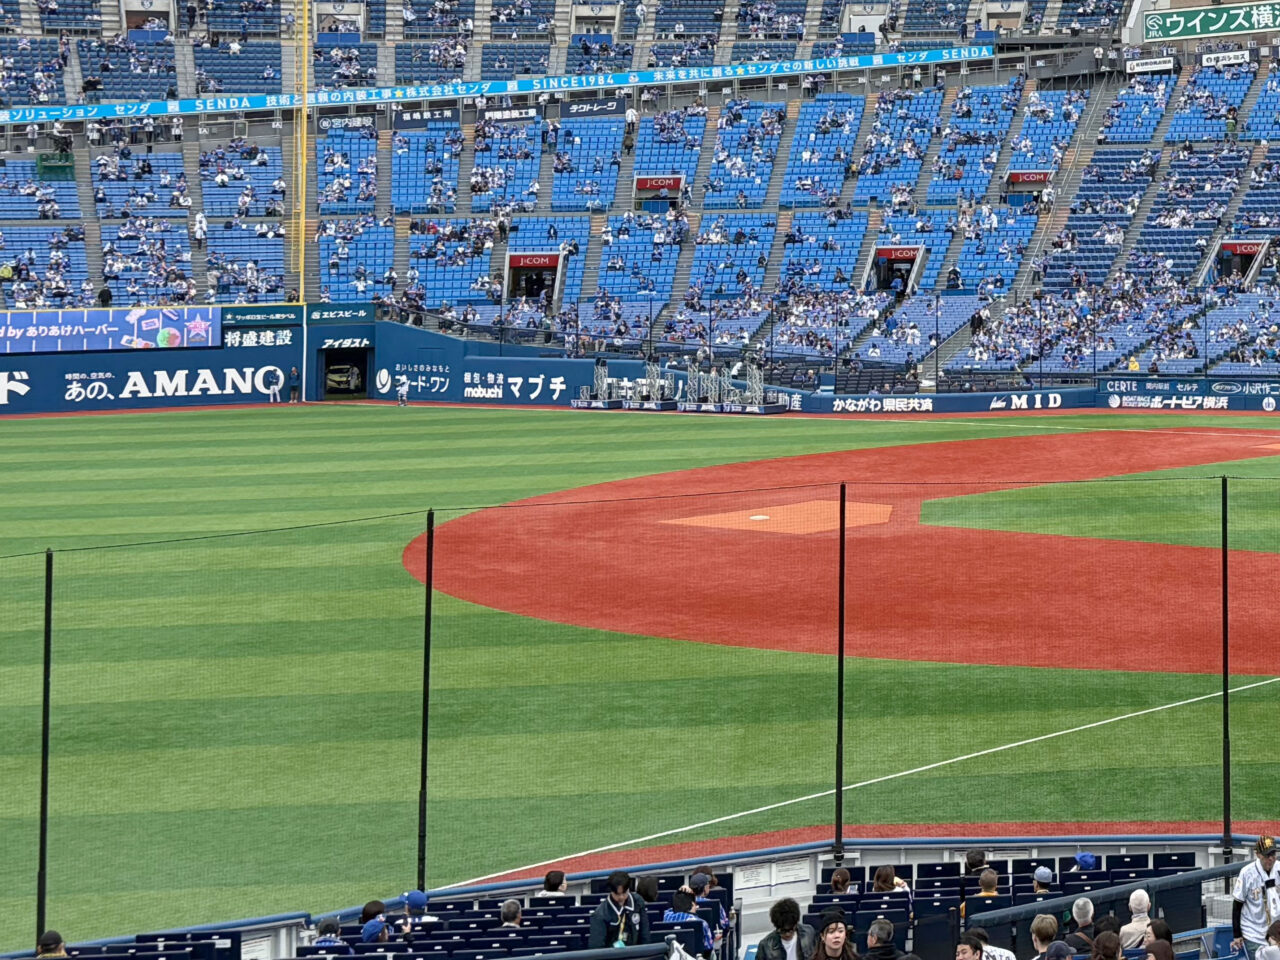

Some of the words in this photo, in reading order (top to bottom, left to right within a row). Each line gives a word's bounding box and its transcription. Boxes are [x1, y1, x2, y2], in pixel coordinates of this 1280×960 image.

[1147, 30, 1163, 38] JRA
[896, 51, 928, 63] センダ
[942, 48, 989, 60] SENDA
[653, 64, 733, 81] 未来を共に創る
[747, 56, 859, 74] センダでの新しい挑戦
[533, 75, 614, 89] SINCE1984
[406, 82, 492, 98] 株式会社センダ
[115, 103, 151, 115] センダ
[195, 97, 250, 110] SENDA
[646, 179, 674, 188] J:COM
[520, 257, 549, 266] J:COM
[7, 326, 25, 339] by
[26, 325, 119, 337] ありあけハーバー
[224, 329, 293, 347] 将盛建設
[321, 338, 370, 349] アイダスト
[118, 366, 285, 399] AMANO
[507, 374, 567, 401] マブチ
[1106, 381, 1138, 393] CERTE
[1176, 382, 1199, 392] セルテ
[65, 381, 115, 402] あの、
[464, 385, 503, 399] mabuchi
[832, 398, 933, 412] かながわ県民共済
[1010, 393, 1062, 409] MID
[1150, 396, 1229, 410] ボートピア横浜
